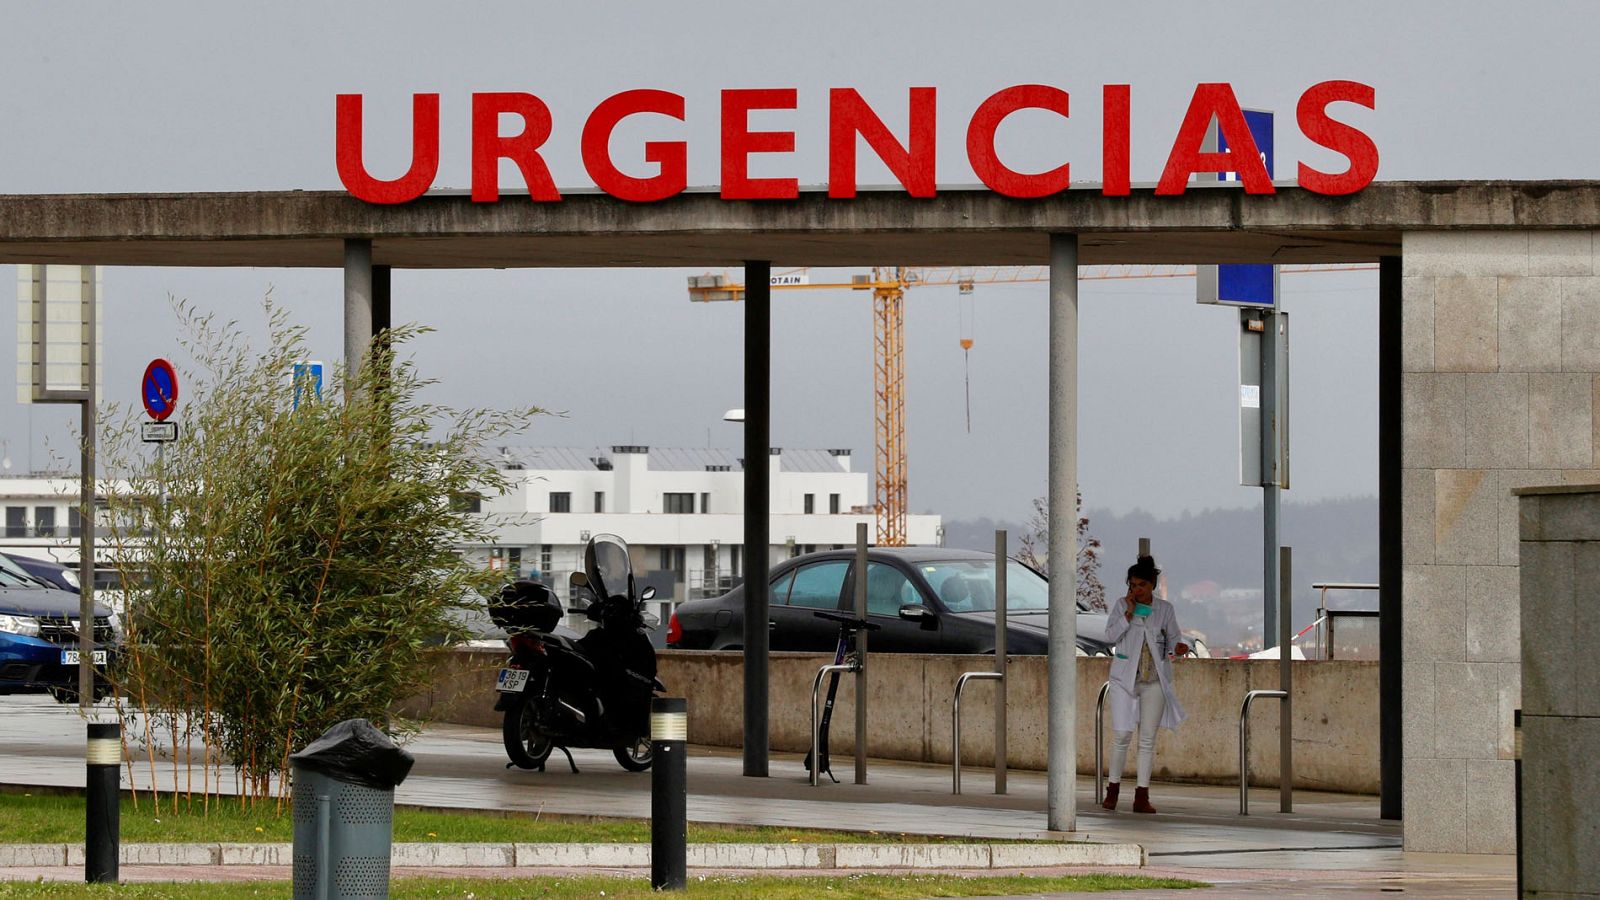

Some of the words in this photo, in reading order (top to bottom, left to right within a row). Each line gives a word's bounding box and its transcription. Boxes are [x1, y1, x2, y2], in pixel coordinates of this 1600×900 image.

[336, 80, 1379, 204] URGENCIAS
[506, 670, 528, 681] 3619
[502, 679, 519, 689] KSP
